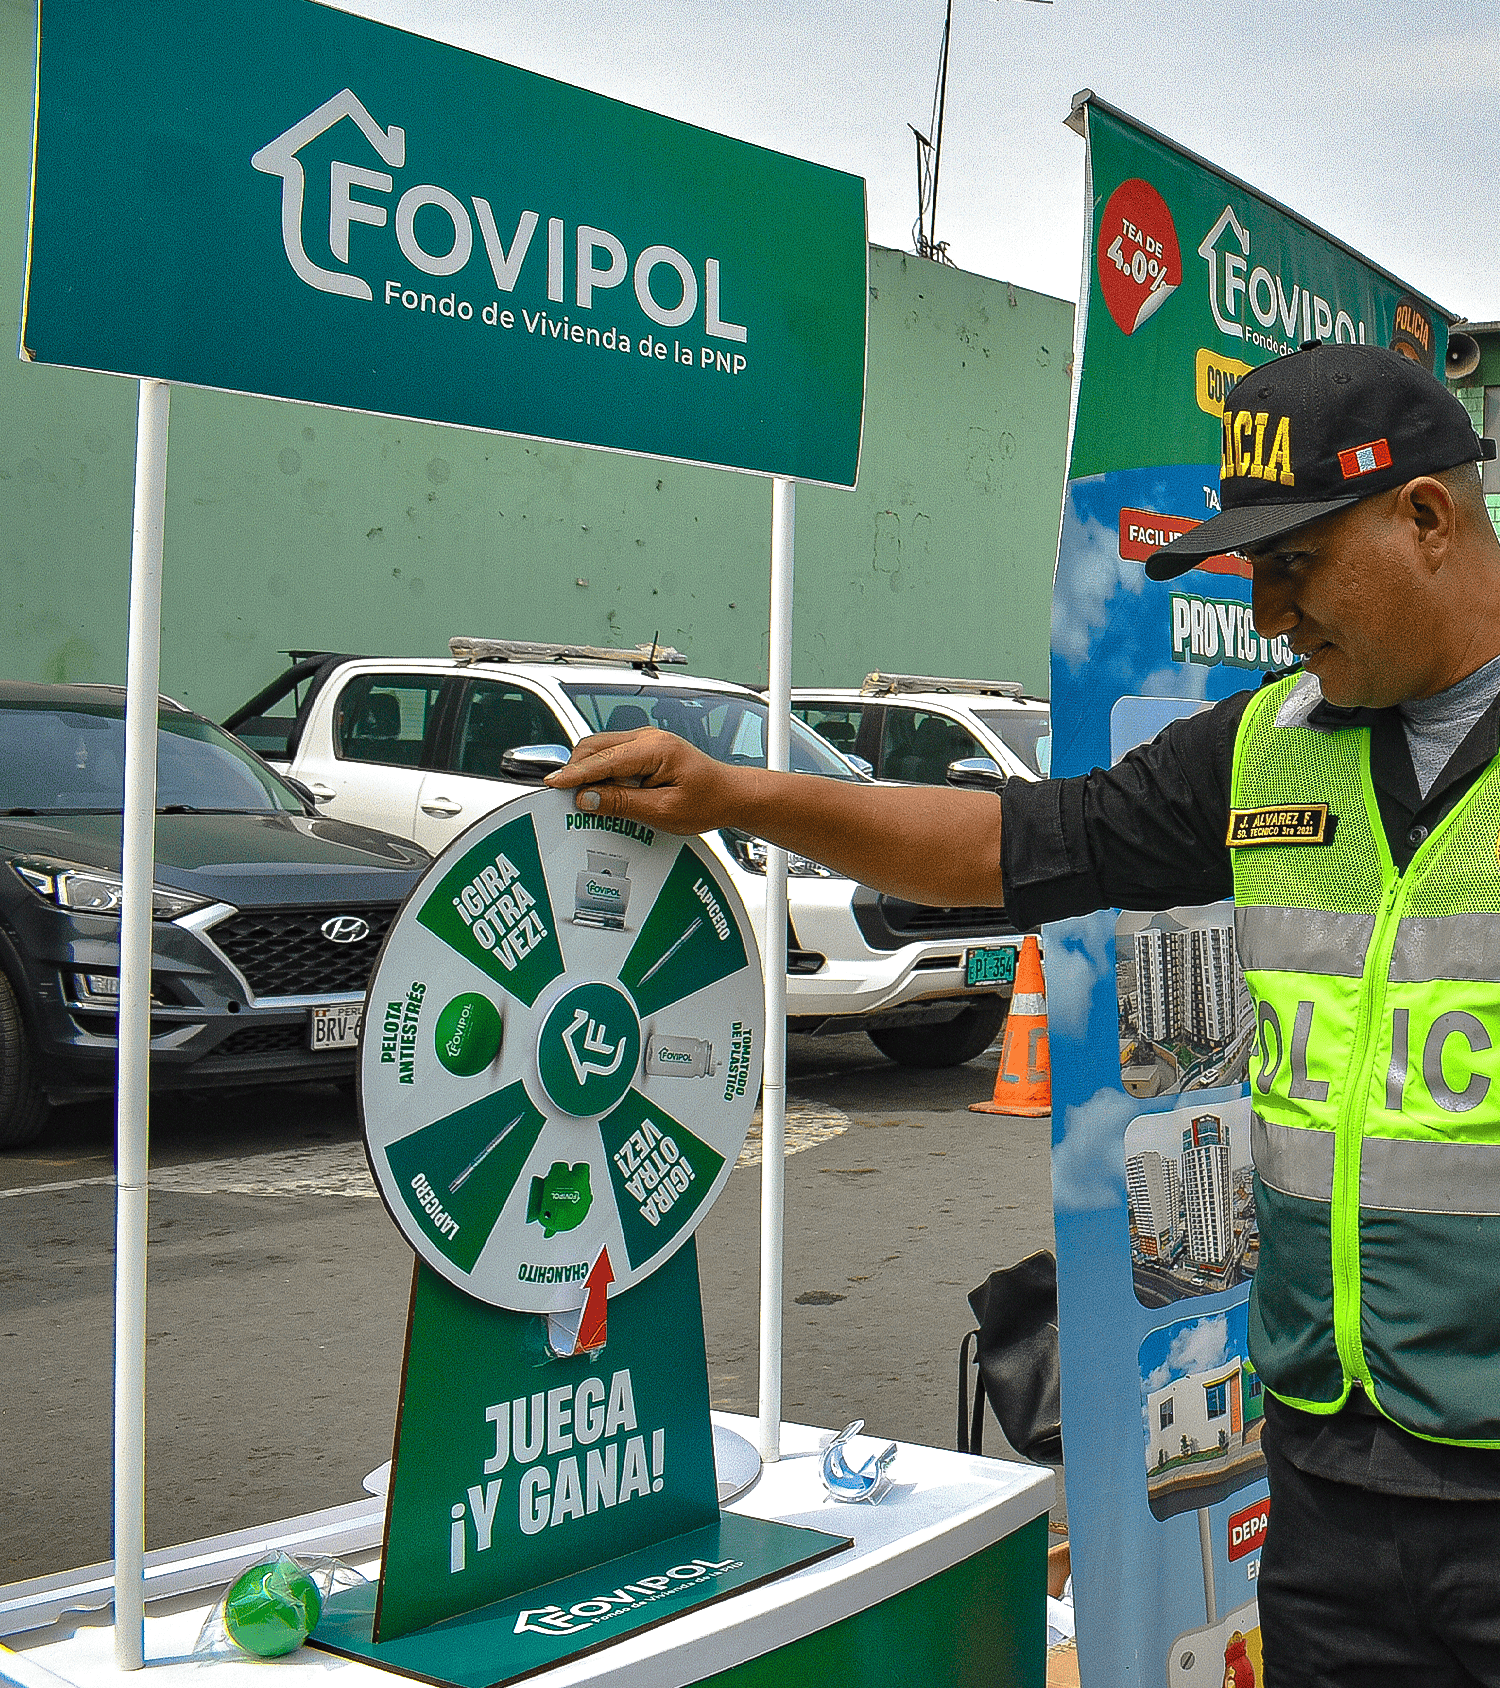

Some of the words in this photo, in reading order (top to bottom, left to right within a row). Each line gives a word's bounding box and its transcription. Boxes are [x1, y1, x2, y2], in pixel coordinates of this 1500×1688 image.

[330, 161, 748, 343] FOVIPOL
[1106, 234, 1168, 292] 4.0%
[1121, 217, 1144, 248] TEA
[1145, 235, 1164, 259] DE
[385, 280, 473, 320] Fondo
[481, 301, 515, 329] de
[522, 308, 631, 353] Vivienda
[639, 335, 668, 361] de
[674, 340, 693, 366] la
[701, 347, 748, 375] PNP
[1245, 326, 1278, 352] Fondo
[1206, 364, 1243, 404] CON
[1220, 410, 1295, 487] ICIA
[565, 813, 656, 846] PORTACELULAR
[1251, 812, 1299, 828] ALVAREZ
[452, 852, 520, 926] ¡GIRA
[472, 881, 537, 950] OTRA
[692, 877, 731, 941] LAPICERO
[492, 909, 548, 971] VEZ!
[380, 1001, 403, 1064] PELOTA
[399, 980, 427, 1085] ANTIESTRÉS
[449, 1003, 473, 1053] FOVIPOL
[731, 1021, 742, 1038] DE
[723, 1041, 741, 1102] PLASTICO
[735, 1028, 752, 1097] TOMATODO
[614, 1118, 663, 1179] VEZ!
[624, 1137, 680, 1203] OTRA
[410, 1172, 461, 1241] LAPICERO
[639, 1156, 696, 1227] ¡GIRA
[517, 1262, 590, 1284] CHANCHITO
[482, 1368, 638, 1475] JUEGA
[448, 1478, 503, 1575] ¡Y
[518, 1427, 665, 1536] GANA!
[537, 1557, 736, 1628] FOVIPOL
[591, 1606, 631, 1624] Fondo
[630, 1600, 648, 1609] de
[644, 1581, 696, 1602] Vivienda
